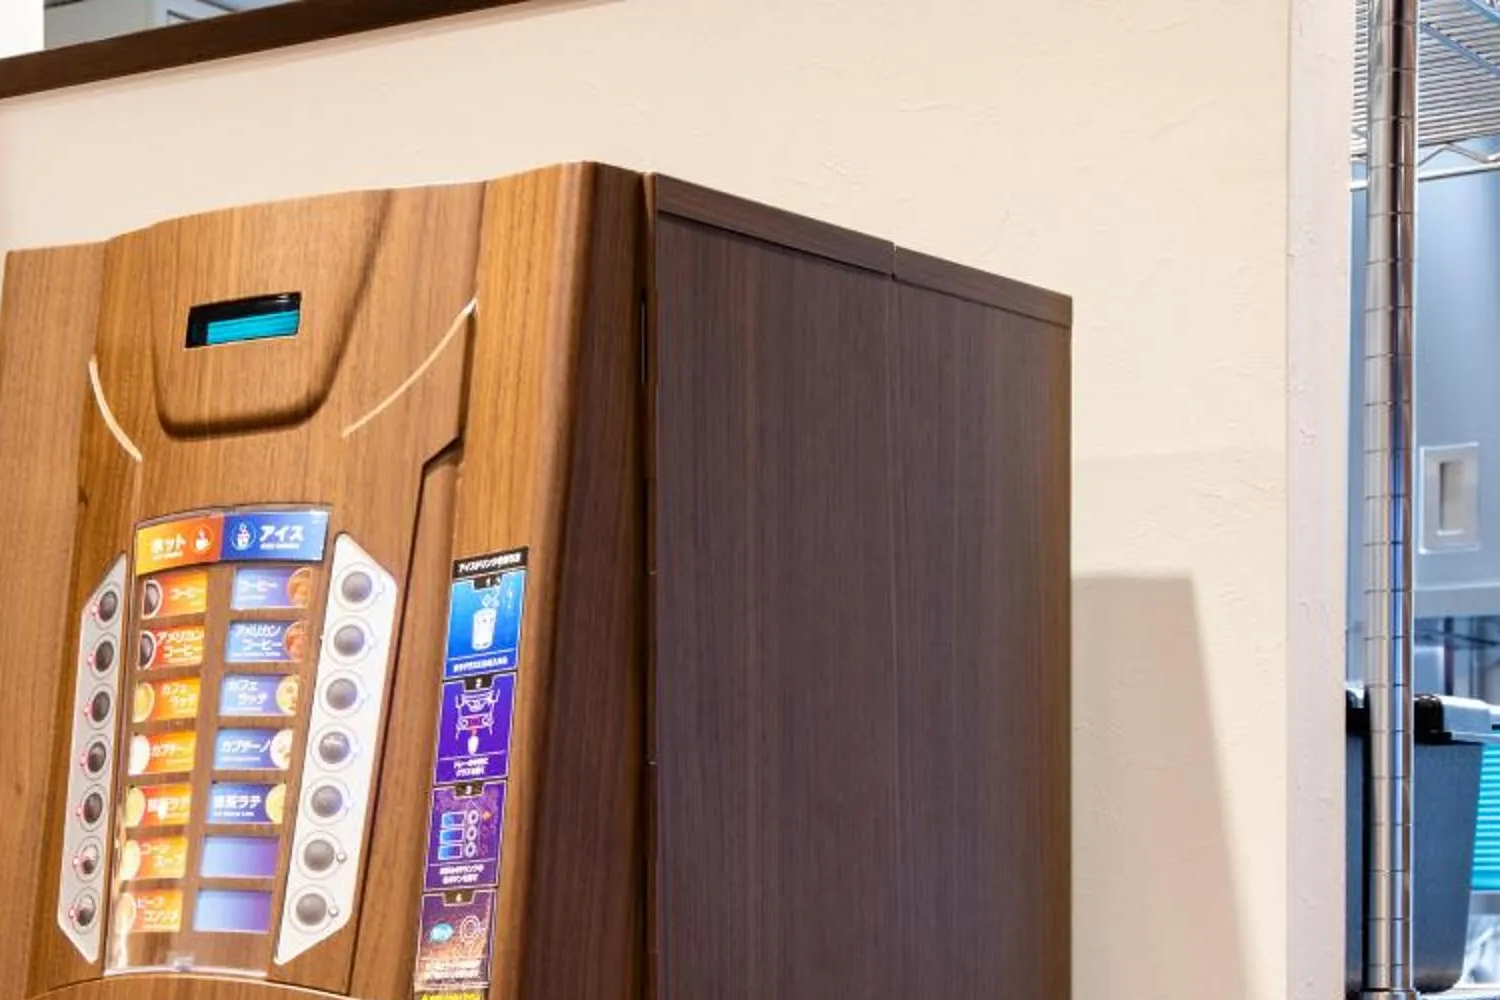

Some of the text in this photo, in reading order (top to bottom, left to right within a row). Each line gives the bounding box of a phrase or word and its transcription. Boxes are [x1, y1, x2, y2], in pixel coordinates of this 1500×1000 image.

[260, 524, 305, 542] アイス
[151, 534, 187, 553] ホット
